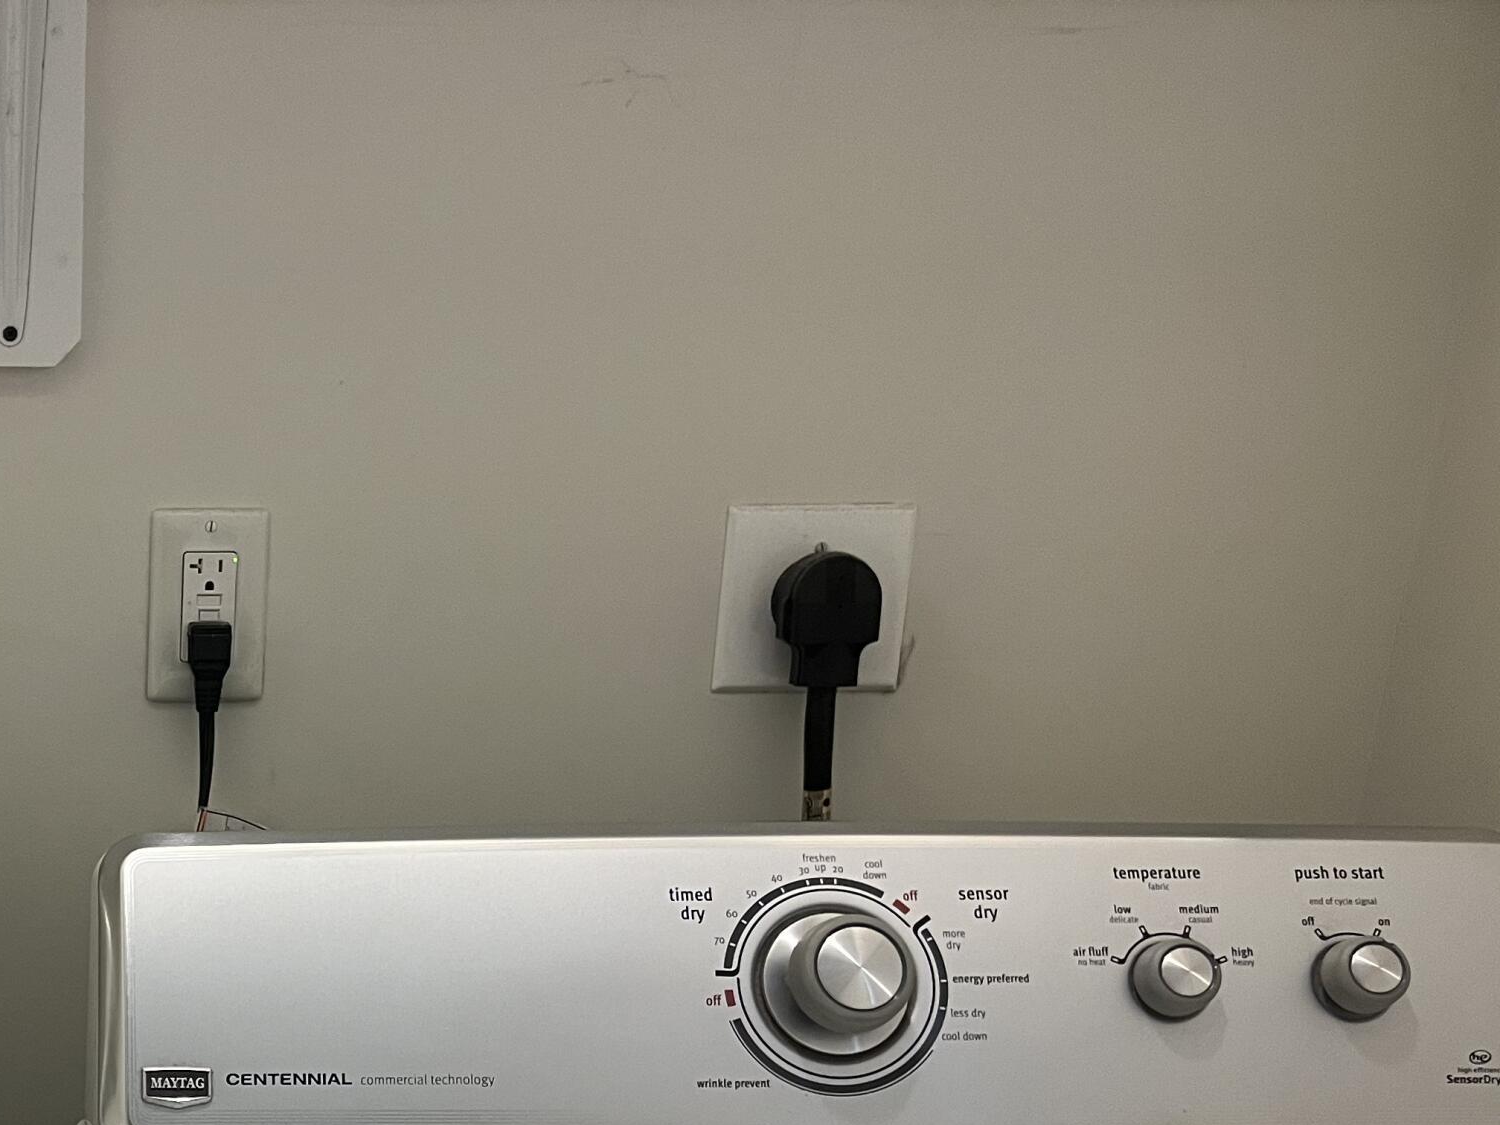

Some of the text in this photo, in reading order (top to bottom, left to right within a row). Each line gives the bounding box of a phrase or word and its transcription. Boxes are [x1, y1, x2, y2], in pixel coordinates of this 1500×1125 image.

[802, 853, 836, 863] freshen
[815, 864, 827, 874] up
[833, 865, 844, 874] 20
[864, 860, 883, 869] cool
[799, 867, 810, 875] 30
[863, 871, 887, 880] down
[1113, 867, 1201, 882] temperature
[1295, 866, 1384, 882] push to start
[771, 874, 783, 883] 40
[1148, 883, 1170, 891] fabric
[669, 888, 712, 902] timed
[746, 890, 757, 899] 50
[903, 890, 918, 901] off
[958, 888, 1009, 902] sensor
[1334, 897, 1353, 907] cycle
[1355, 897, 1377, 907] signal
[726, 910, 738, 918] 60
[974, 905, 998, 922] dry
[1113, 905, 1131, 914] low
[1179, 904, 1219, 914] medium
[681, 907, 705, 923] dry
[1110, 915, 1139, 923] delicate
[1188, 915, 1212, 923] casual
[1302, 917, 1315, 926] off
[1378, 918, 1390, 926] on
[943, 930, 966, 938] more
[714, 936, 725, 945] 70
[946, 941, 962, 951] dry
[1073, 947, 1109, 957] air fluff
[1231, 947, 1254, 958] high
[952, 973, 1030, 986] energy preferred
[706, 995, 722, 1006] off
[950, 1008, 986, 1020] less dry
[942, 1032, 988, 1041] cool down
[150, 1077, 206, 1089] MAYTAG
[226, 1072, 495, 1087] CENTENNIAL commercial technology
[697, 1078, 771, 1090] wrinkle prevent
[1446, 1074, 1500, 1086] SensorDry
